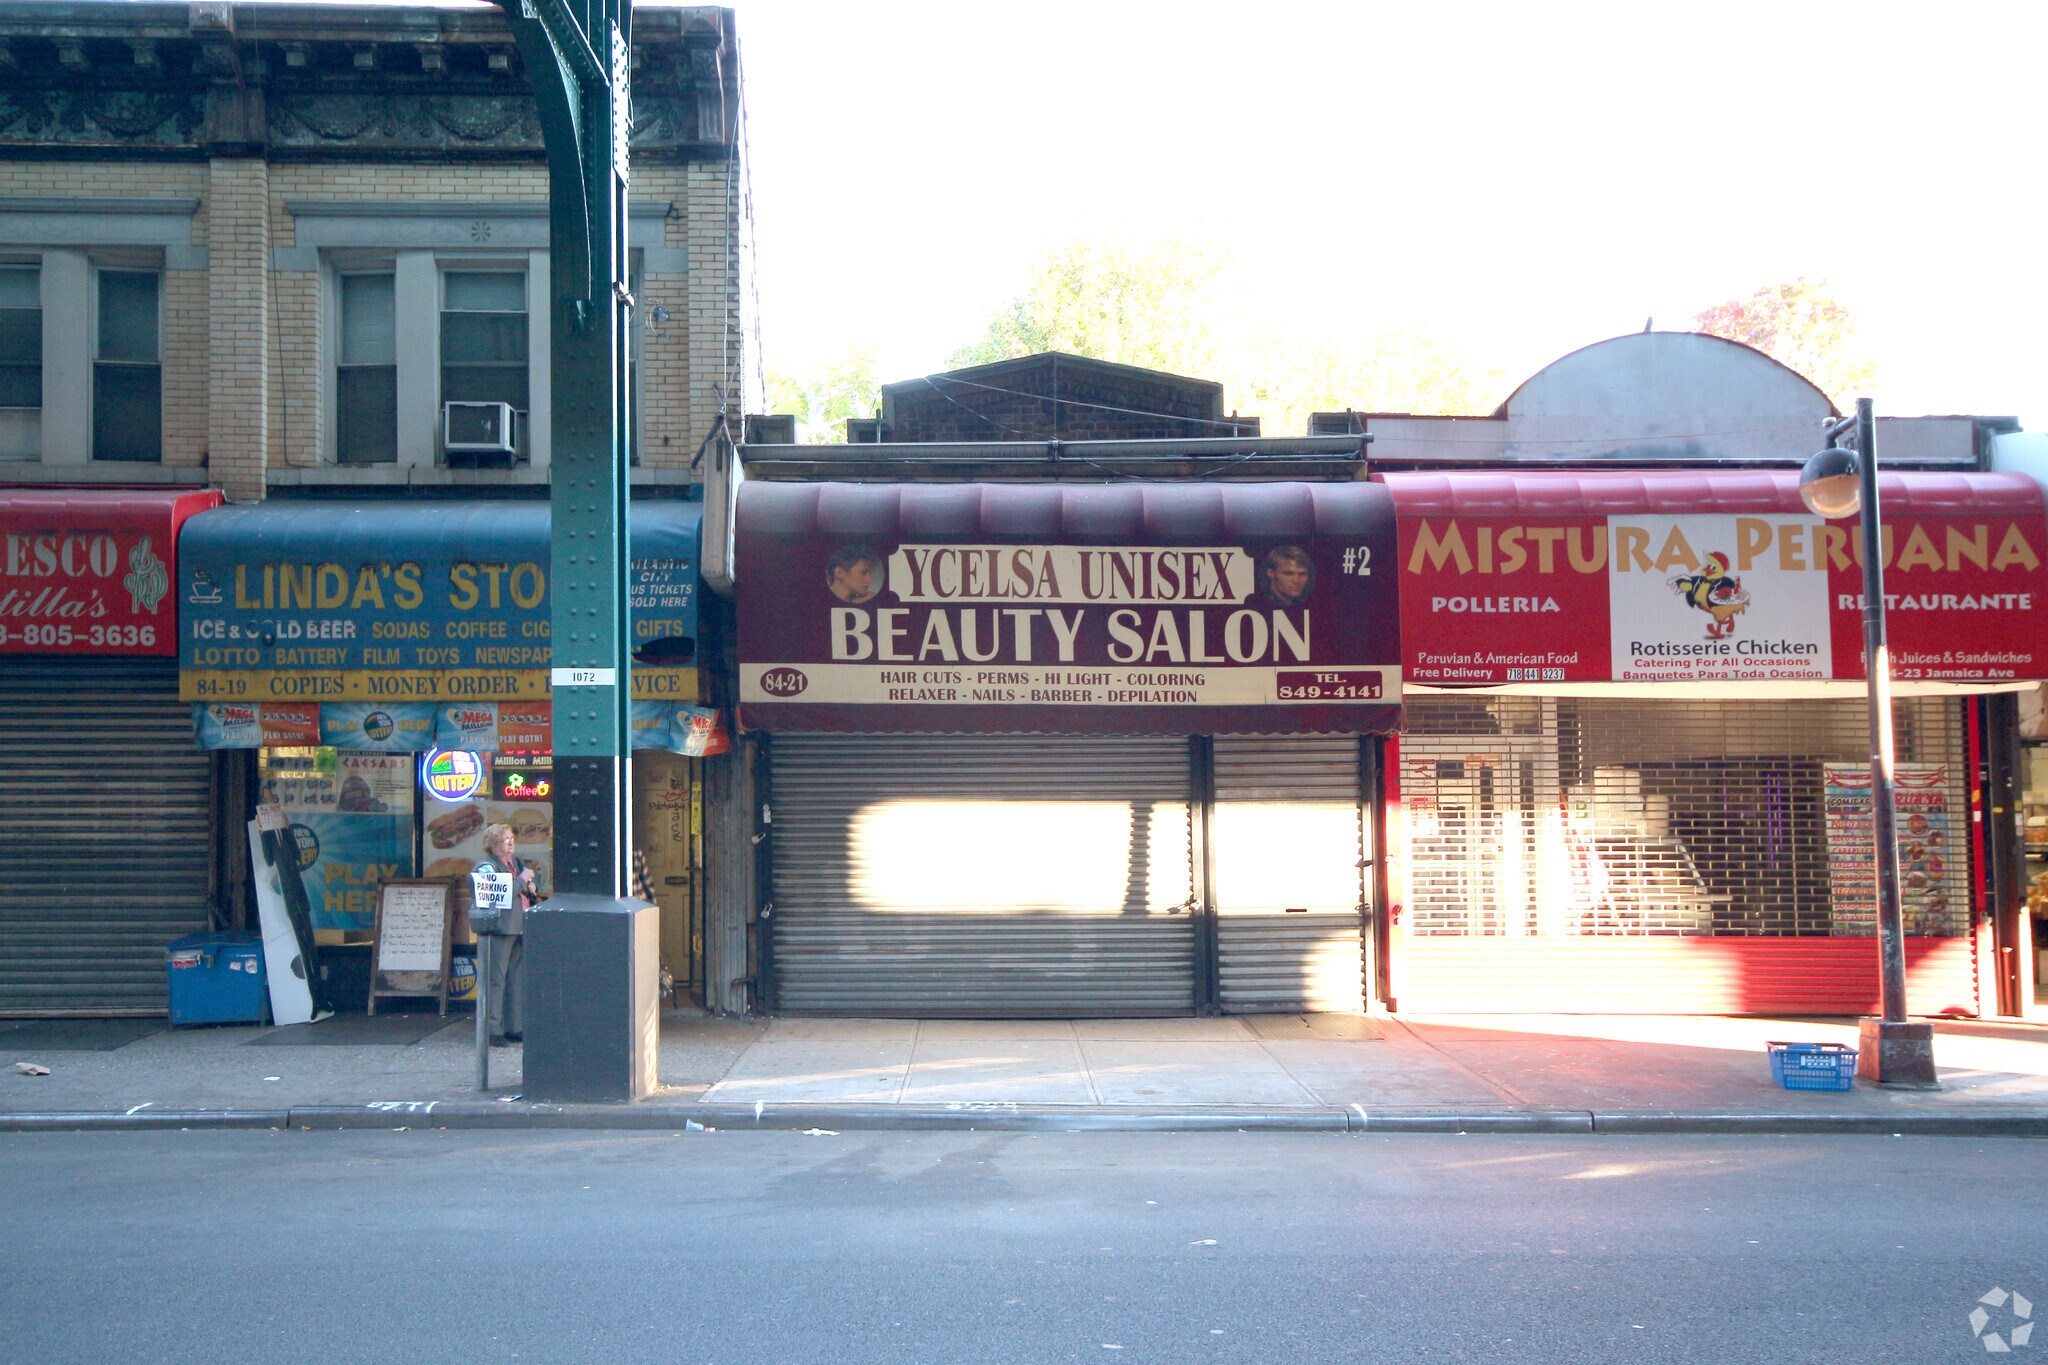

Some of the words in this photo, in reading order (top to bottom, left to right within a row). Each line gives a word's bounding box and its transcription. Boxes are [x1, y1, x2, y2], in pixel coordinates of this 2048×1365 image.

[1407, 517, 1701, 576] MISTURA
[1735, 516, 2041, 573] PERUANA
[0, 534, 118, 577] ESCO
[1342, 546, 1372, 576] #2
[640, 572, 671, 582] CITY
[902, 548, 1062, 599] YCELSA
[1077, 550, 1236, 601] UNISEX
[235, 563, 424, 610] LINDA'S
[449, 562, 546, 610] STO
[650, 584, 692, 595] TICKETS
[630, 597, 656, 607] SOLD
[661, 597, 688, 607] HERE
[1431, 596, 1561, 613] POLLERIA
[1838, 593, 2032, 610] RETAURANTE
[193, 620, 226, 639] ICE
[229, 625, 241, 639] &
[246, 620, 301, 640] CLD
[306, 620, 356, 639] BEER
[372, 621, 430, 639] SODAS
[445, 621, 507, 638] COFFEE
[636, 619, 684, 636] GIFTS
[831, 607, 1085, 661] BEAUTY
[1107, 608, 1310, 663] SALON
[1630, 641, 1730, 656] Rotisserie
[1736, 640, 1818, 655] Chicken
[194, 647, 261, 665] LOTTO
[275, 647, 348, 665] BATTERY
[363, 648, 400, 665] FILM
[416, 647, 460, 665] TOYS
[1418, 652, 1473, 665] Peruvian
[1474, 653, 1483, 664] &
[1484, 652, 1545, 664] American
[1547, 651, 1578, 664] Food
[1899, 651, 1941, 664] Juices
[1942, 652, 1954, 663] &
[1955, 651, 2032, 664] Sandwiches
[1634, 658, 1691, 670] Catering
[1696, 658, 1718, 668] For
[1722, 657, 1739, 667] All
[1743, 657, 1811, 667] Occasions
[572, 672, 595, 682] 1072
[881, 671, 917, 684] HAIR
[923, 671, 961, 685] CUTS
[977, 672, 1029, 685] PERMS
[1045, 672, 1061, 685] HI
[1066, 673, 1112, 686] LIGHT
[1126, 673, 1206, 686] COLORING
[1315, 673, 1347, 683] TEL.
[1413, 667, 1441, 678] Free
[1443, 667, 1493, 680] Delivery
[1507, 668, 1522, 680] 718
[1525, 668, 1540, 680] 441
[1542, 668, 1565, 680] 3237
[1623, 670, 1694, 681] Banquetes
[1698, 669, 1728, 679] Para
[1734, 669, 1766, 678] Toda
[1769, 669, 1823, 678] Ocasion
[1889, 668, 1922, 678] 4-23
[1925, 667, 1986, 678] Jamaica
[1988, 668, 2015, 678] Ave
[197, 679, 247, 695] 84-19
[270, 676, 345, 695] COPIES
[367, 676, 441, 695] MONEY
[448, 675, 520, 694] ORDER
[631, 675, 680, 693] VICE
[765, 673, 803, 692] 84-21
[889, 688, 957, 701] RELAXER
[972, 688, 1015, 702] NAILS
[1030, 689, 1092, 702] BARBER
[1108, 690, 1197, 703] DEPILATION
[1279, 685, 1381, 699] 849-4141
[462, 710, 494, 723] MEGA
[500, 735, 516, 743] PLAY
[519, 734, 543, 743] BOTH!
[342, 757, 407, 769] CAESARS
[494, 756, 526, 766] Million
[504, 785, 538, 797] Coffee
[325, 864, 399, 885] PLAY
[486, 873, 497, 882] NO
[476, 882, 508, 893] PARKING
[478, 892, 506, 903] SUNDAY
[453, 957, 469, 965] NEW
[455, 965, 474, 976] YORK
